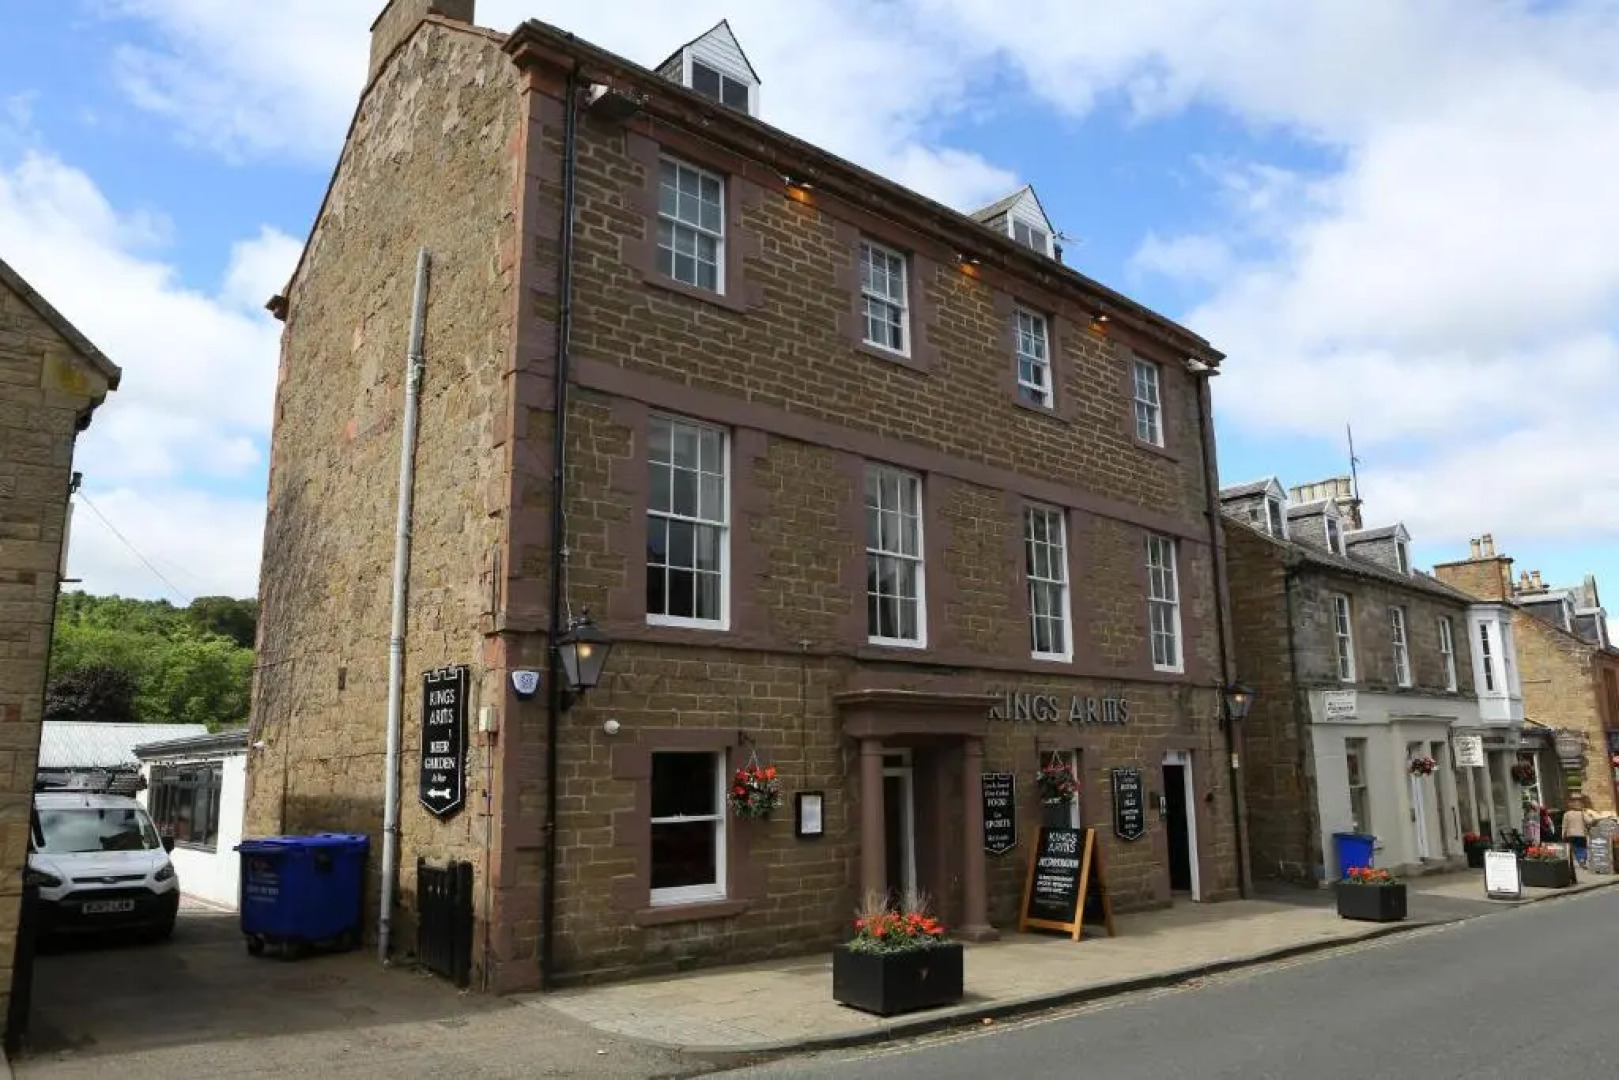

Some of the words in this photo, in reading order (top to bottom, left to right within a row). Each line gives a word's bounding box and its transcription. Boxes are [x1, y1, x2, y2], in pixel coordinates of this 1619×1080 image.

[429, 689, 455, 706] KINGS
[987, 691, 1060, 722] KINGS
[1068, 695, 1129, 722] ARMS
[429, 708, 454, 725] ARMS
